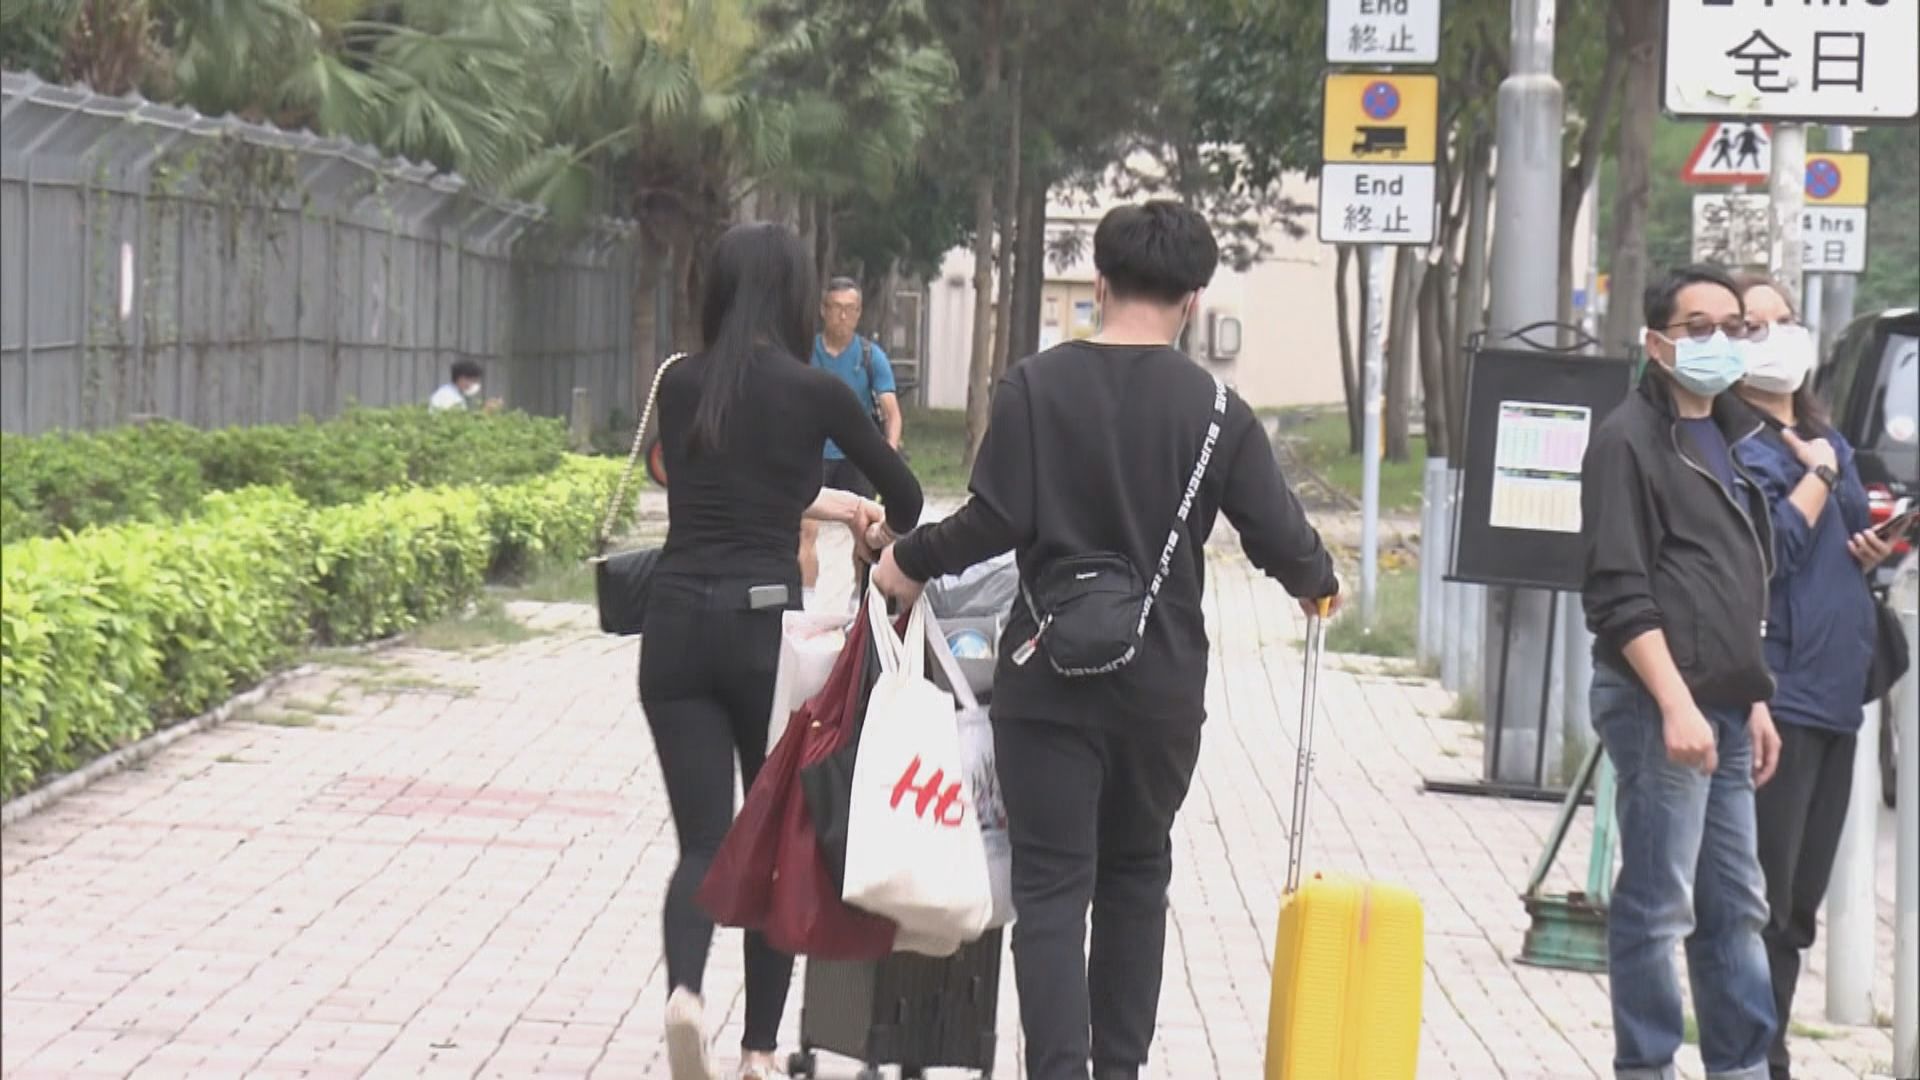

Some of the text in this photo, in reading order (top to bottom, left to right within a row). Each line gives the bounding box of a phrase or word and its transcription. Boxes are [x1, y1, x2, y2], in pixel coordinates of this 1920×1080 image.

[1359, 0, 1408, 15] End
[1348, 23, 1416, 54] 終止
[1355, 174, 1404, 196] End
[1343, 204, 1411, 233] 終止
[1820, 214, 1855, 233] hrs
[1177, 421, 1221, 522] SUPREME
